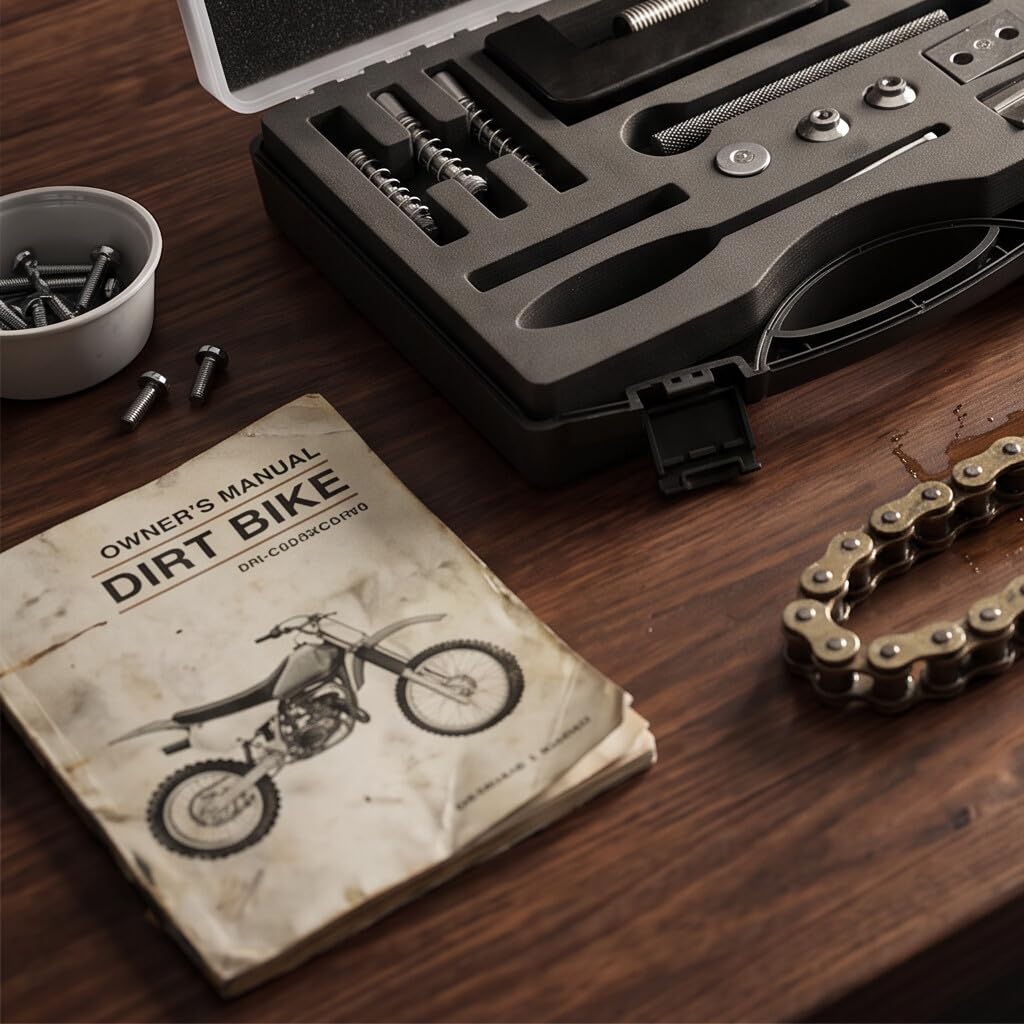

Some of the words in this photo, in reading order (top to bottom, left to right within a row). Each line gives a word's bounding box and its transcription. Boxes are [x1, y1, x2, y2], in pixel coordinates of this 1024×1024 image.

[100, 497, 216, 560] OWNER'S
[217, 447, 321, 503] MANUAL
[101, 530, 218, 604] DIRT
[228, 468, 350, 541] BIKE
